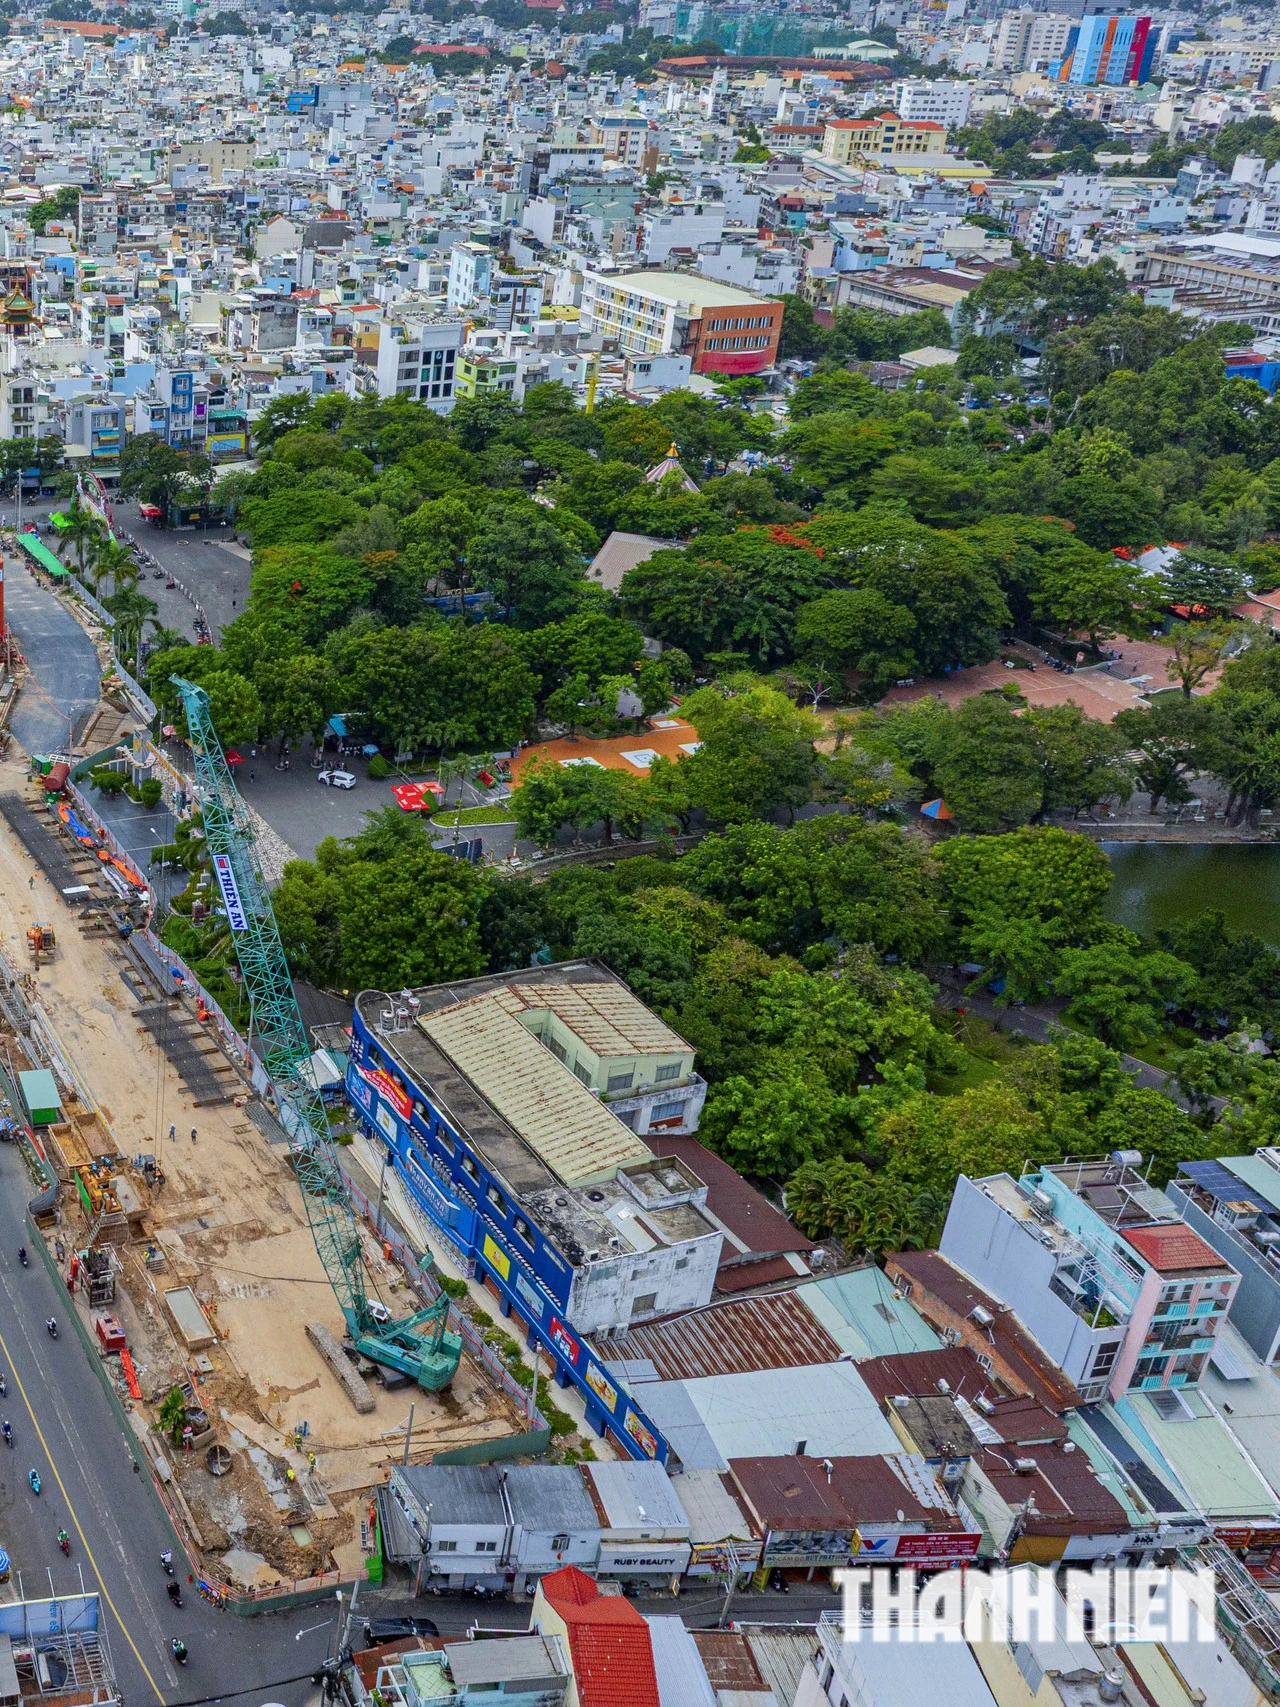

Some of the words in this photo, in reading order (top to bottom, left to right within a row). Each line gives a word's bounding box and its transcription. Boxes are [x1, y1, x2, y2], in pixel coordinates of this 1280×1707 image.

[231, 912, 245, 928] AN
[614, 1558, 638, 1566] RUBY
[639, 1558, 675, 1566] BEAUTY
